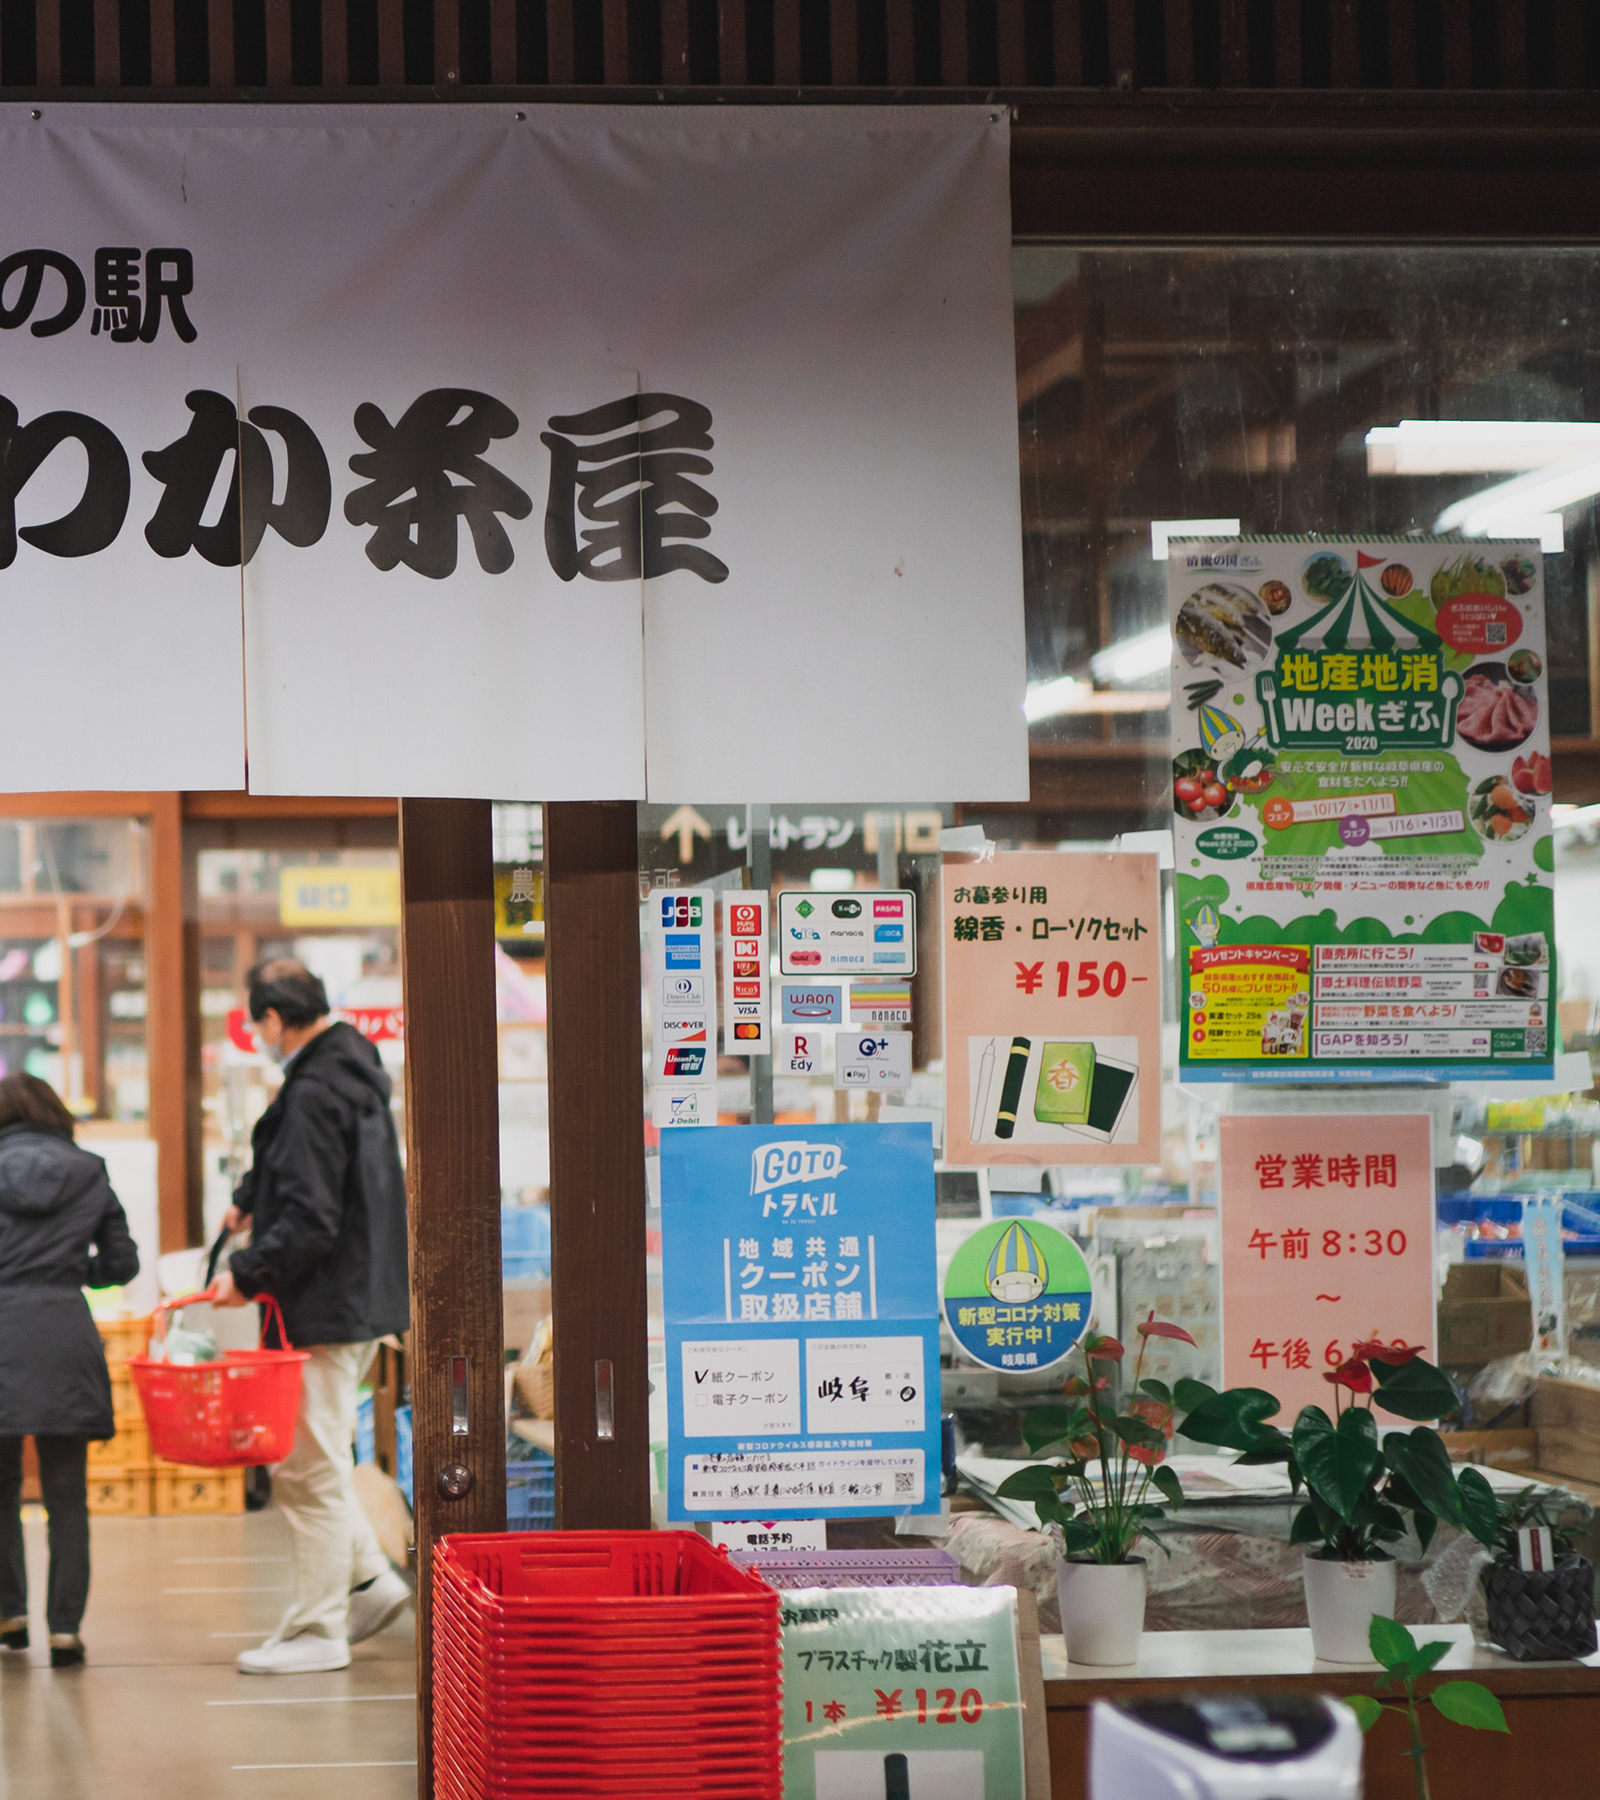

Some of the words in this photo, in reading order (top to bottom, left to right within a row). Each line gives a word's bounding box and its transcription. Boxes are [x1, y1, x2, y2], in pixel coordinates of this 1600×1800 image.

[1281, 653, 1438, 692] 地産地消
[1345, 736, 1378, 750] 2020
[953, 886, 1048, 904] お墓参り用
[953, 916, 1148, 941] 線香・ローソクセット
[830, 954, 865, 963] nimoca
[1201, 949, 1299, 963] プレゼントキャンペーン
[1321, 947, 1414, 960] 直売所に行こう!
[790, 994, 835, 1004] WAON
[664, 1021, 704, 1029] DISCOVER
[871, 1010, 907, 1021] nanaco
[794, 1036, 809, 1055] R
[1320, 1034, 1408, 1047] GAPを知ろう!
[667, 1054, 703, 1065] UnionPay
[790, 1059, 813, 1071] Edy
[1046, 1060, 1081, 1092] 香
[1255, 1154, 1398, 1189] 営業時間
[762, 1192, 839, 1218] トラベル
[738, 1236, 860, 1259] 地域共通
[1248, 1230, 1310, 1260] 午前
[1322, 1229, 1408, 1258] 8:30
[739, 1261, 861, 1290] クーポン
[739, 1291, 863, 1321] 取扱店舗
[958, 1303, 1081, 1326] 新型コロナ対策
[987, 1326, 1053, 1347] 実行中!
[1001, 1352, 1038, 1368] 岐阜県
[1249, 1338, 1312, 1370] 午後
[711, 1370, 775, 1384] 紙クーポン
[818, 1375, 873, 1403] 岐阜
[712, 1393, 789, 1406] 電子クーポン
[746, 1533, 793, 1545] 電話予約
[797, 1640, 989, 1673] プラスチック製花立
[805, 1700, 847, 1724] 1本
